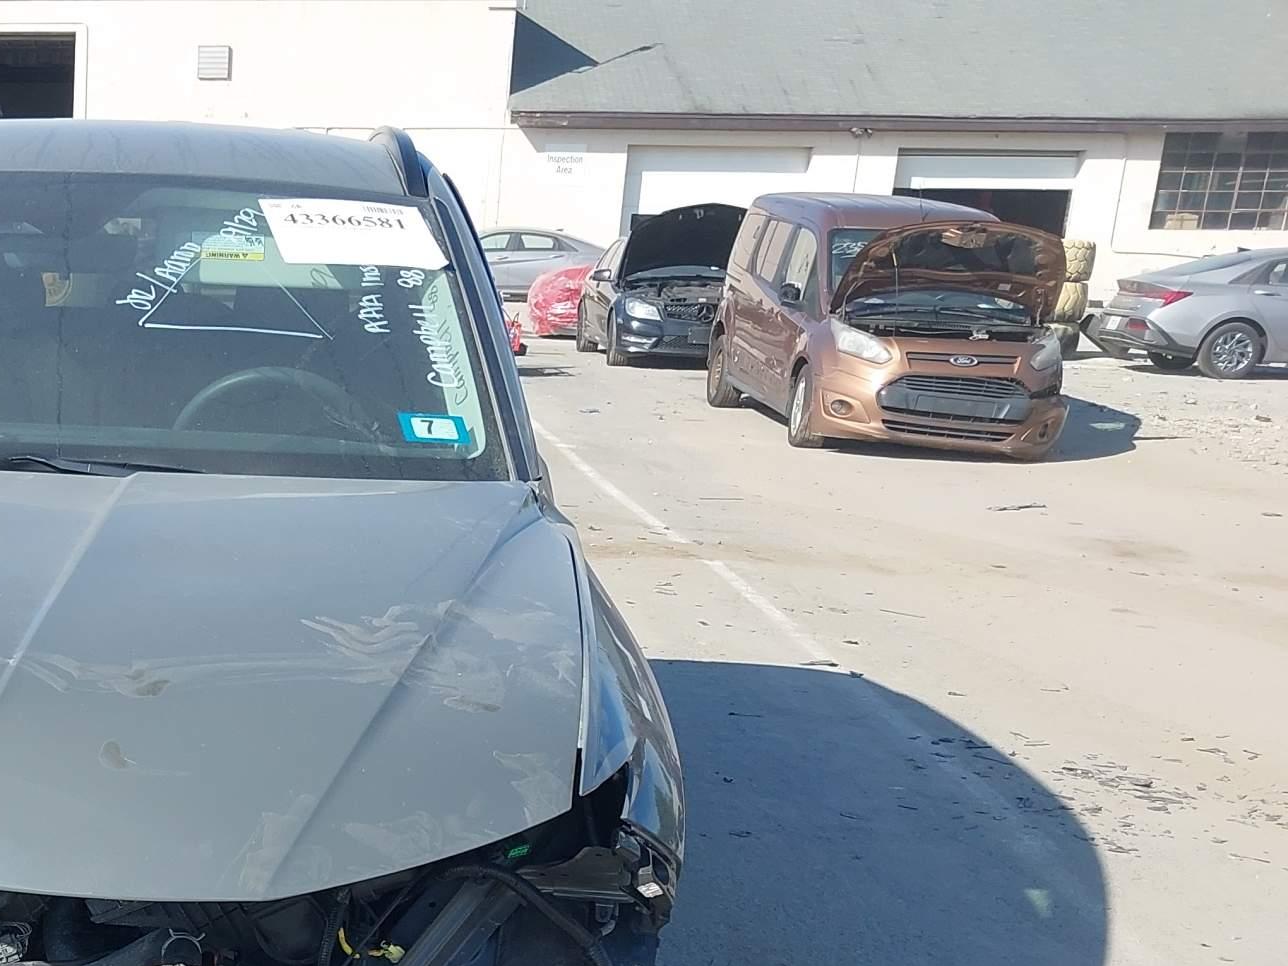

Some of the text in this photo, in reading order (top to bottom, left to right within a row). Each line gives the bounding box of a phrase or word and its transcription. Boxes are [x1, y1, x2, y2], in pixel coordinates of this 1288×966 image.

[547, 153, 583, 165] Inspection
[556, 165, 573, 174] Area
[283, 213, 407, 230] 43366581
[420, 419, 434, 435] 7
